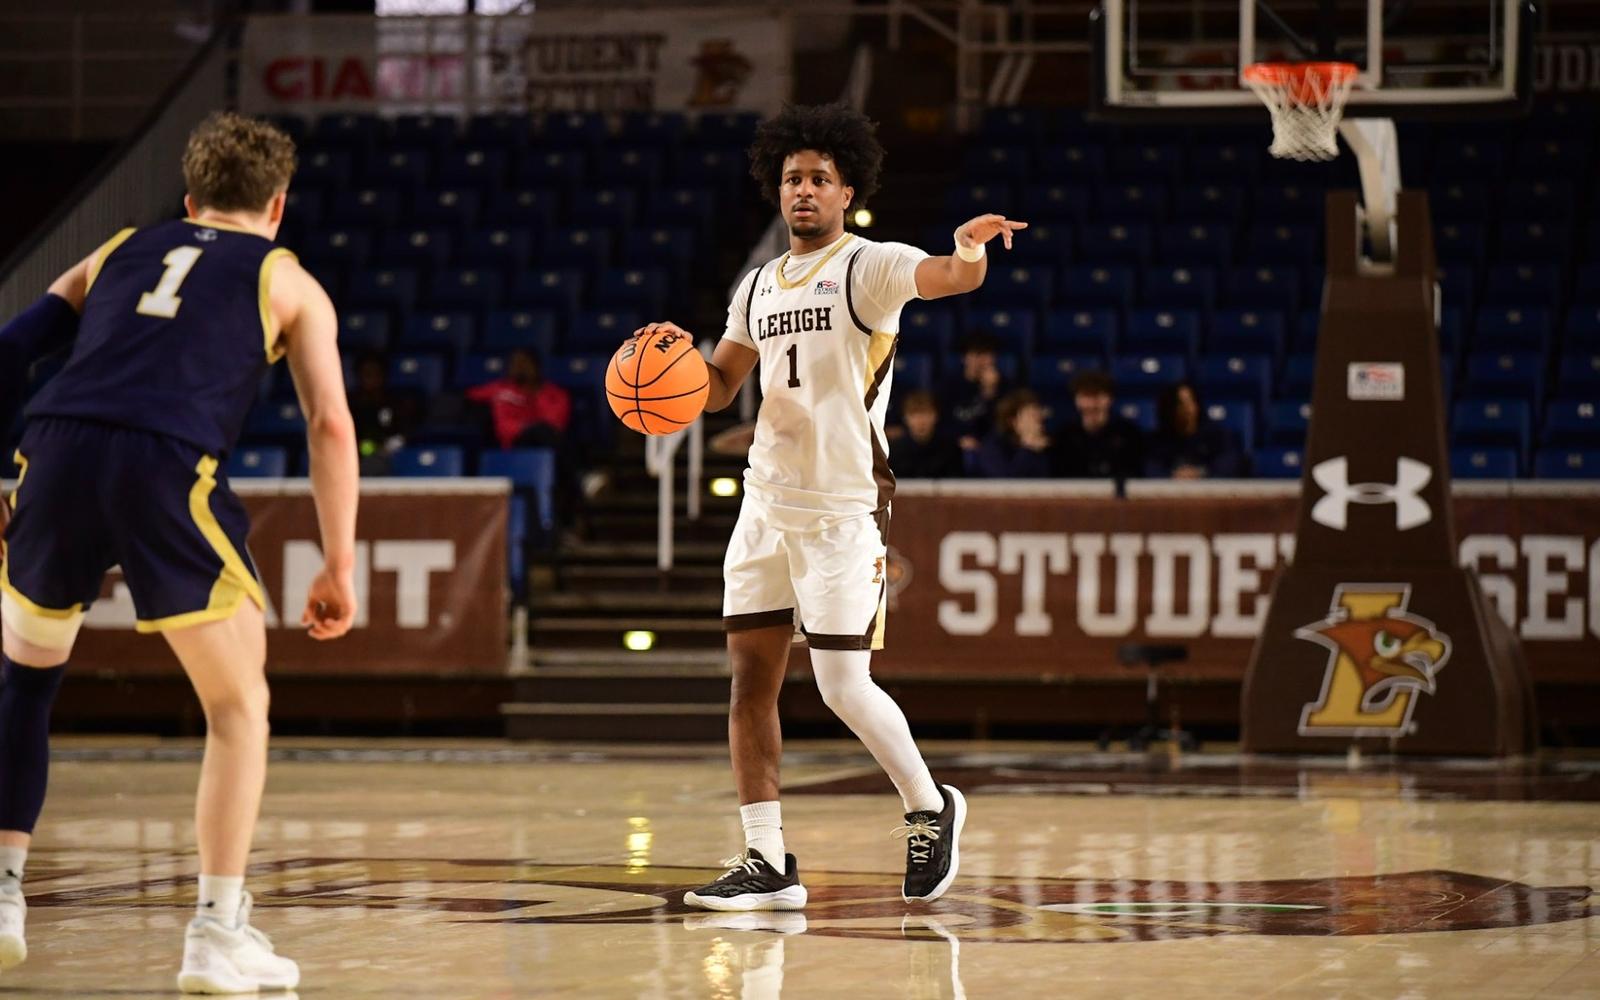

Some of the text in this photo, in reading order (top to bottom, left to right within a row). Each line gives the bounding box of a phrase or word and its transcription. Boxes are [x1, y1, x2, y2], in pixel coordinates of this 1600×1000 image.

[136, 245, 203, 319] 1
[757, 307, 832, 341] LEHIGH
[786, 343, 801, 388] 1
[938, 531, 1600, 640] STUDE SE
